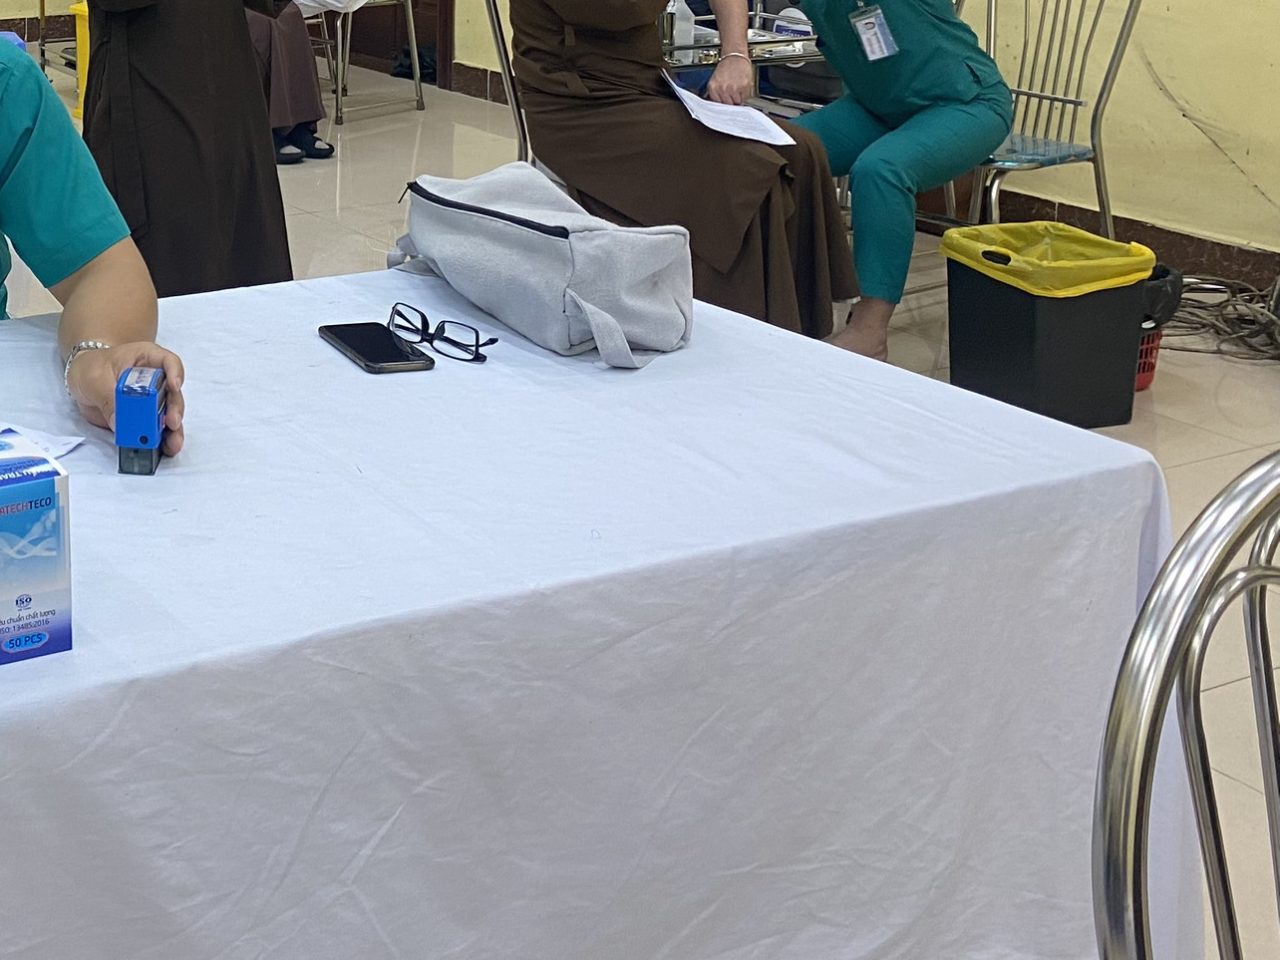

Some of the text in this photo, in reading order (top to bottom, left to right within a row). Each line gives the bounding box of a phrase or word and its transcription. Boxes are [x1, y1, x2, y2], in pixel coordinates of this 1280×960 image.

[15, 596, 33, 606] ISO
[8, 633, 43, 649] 50 PCS
